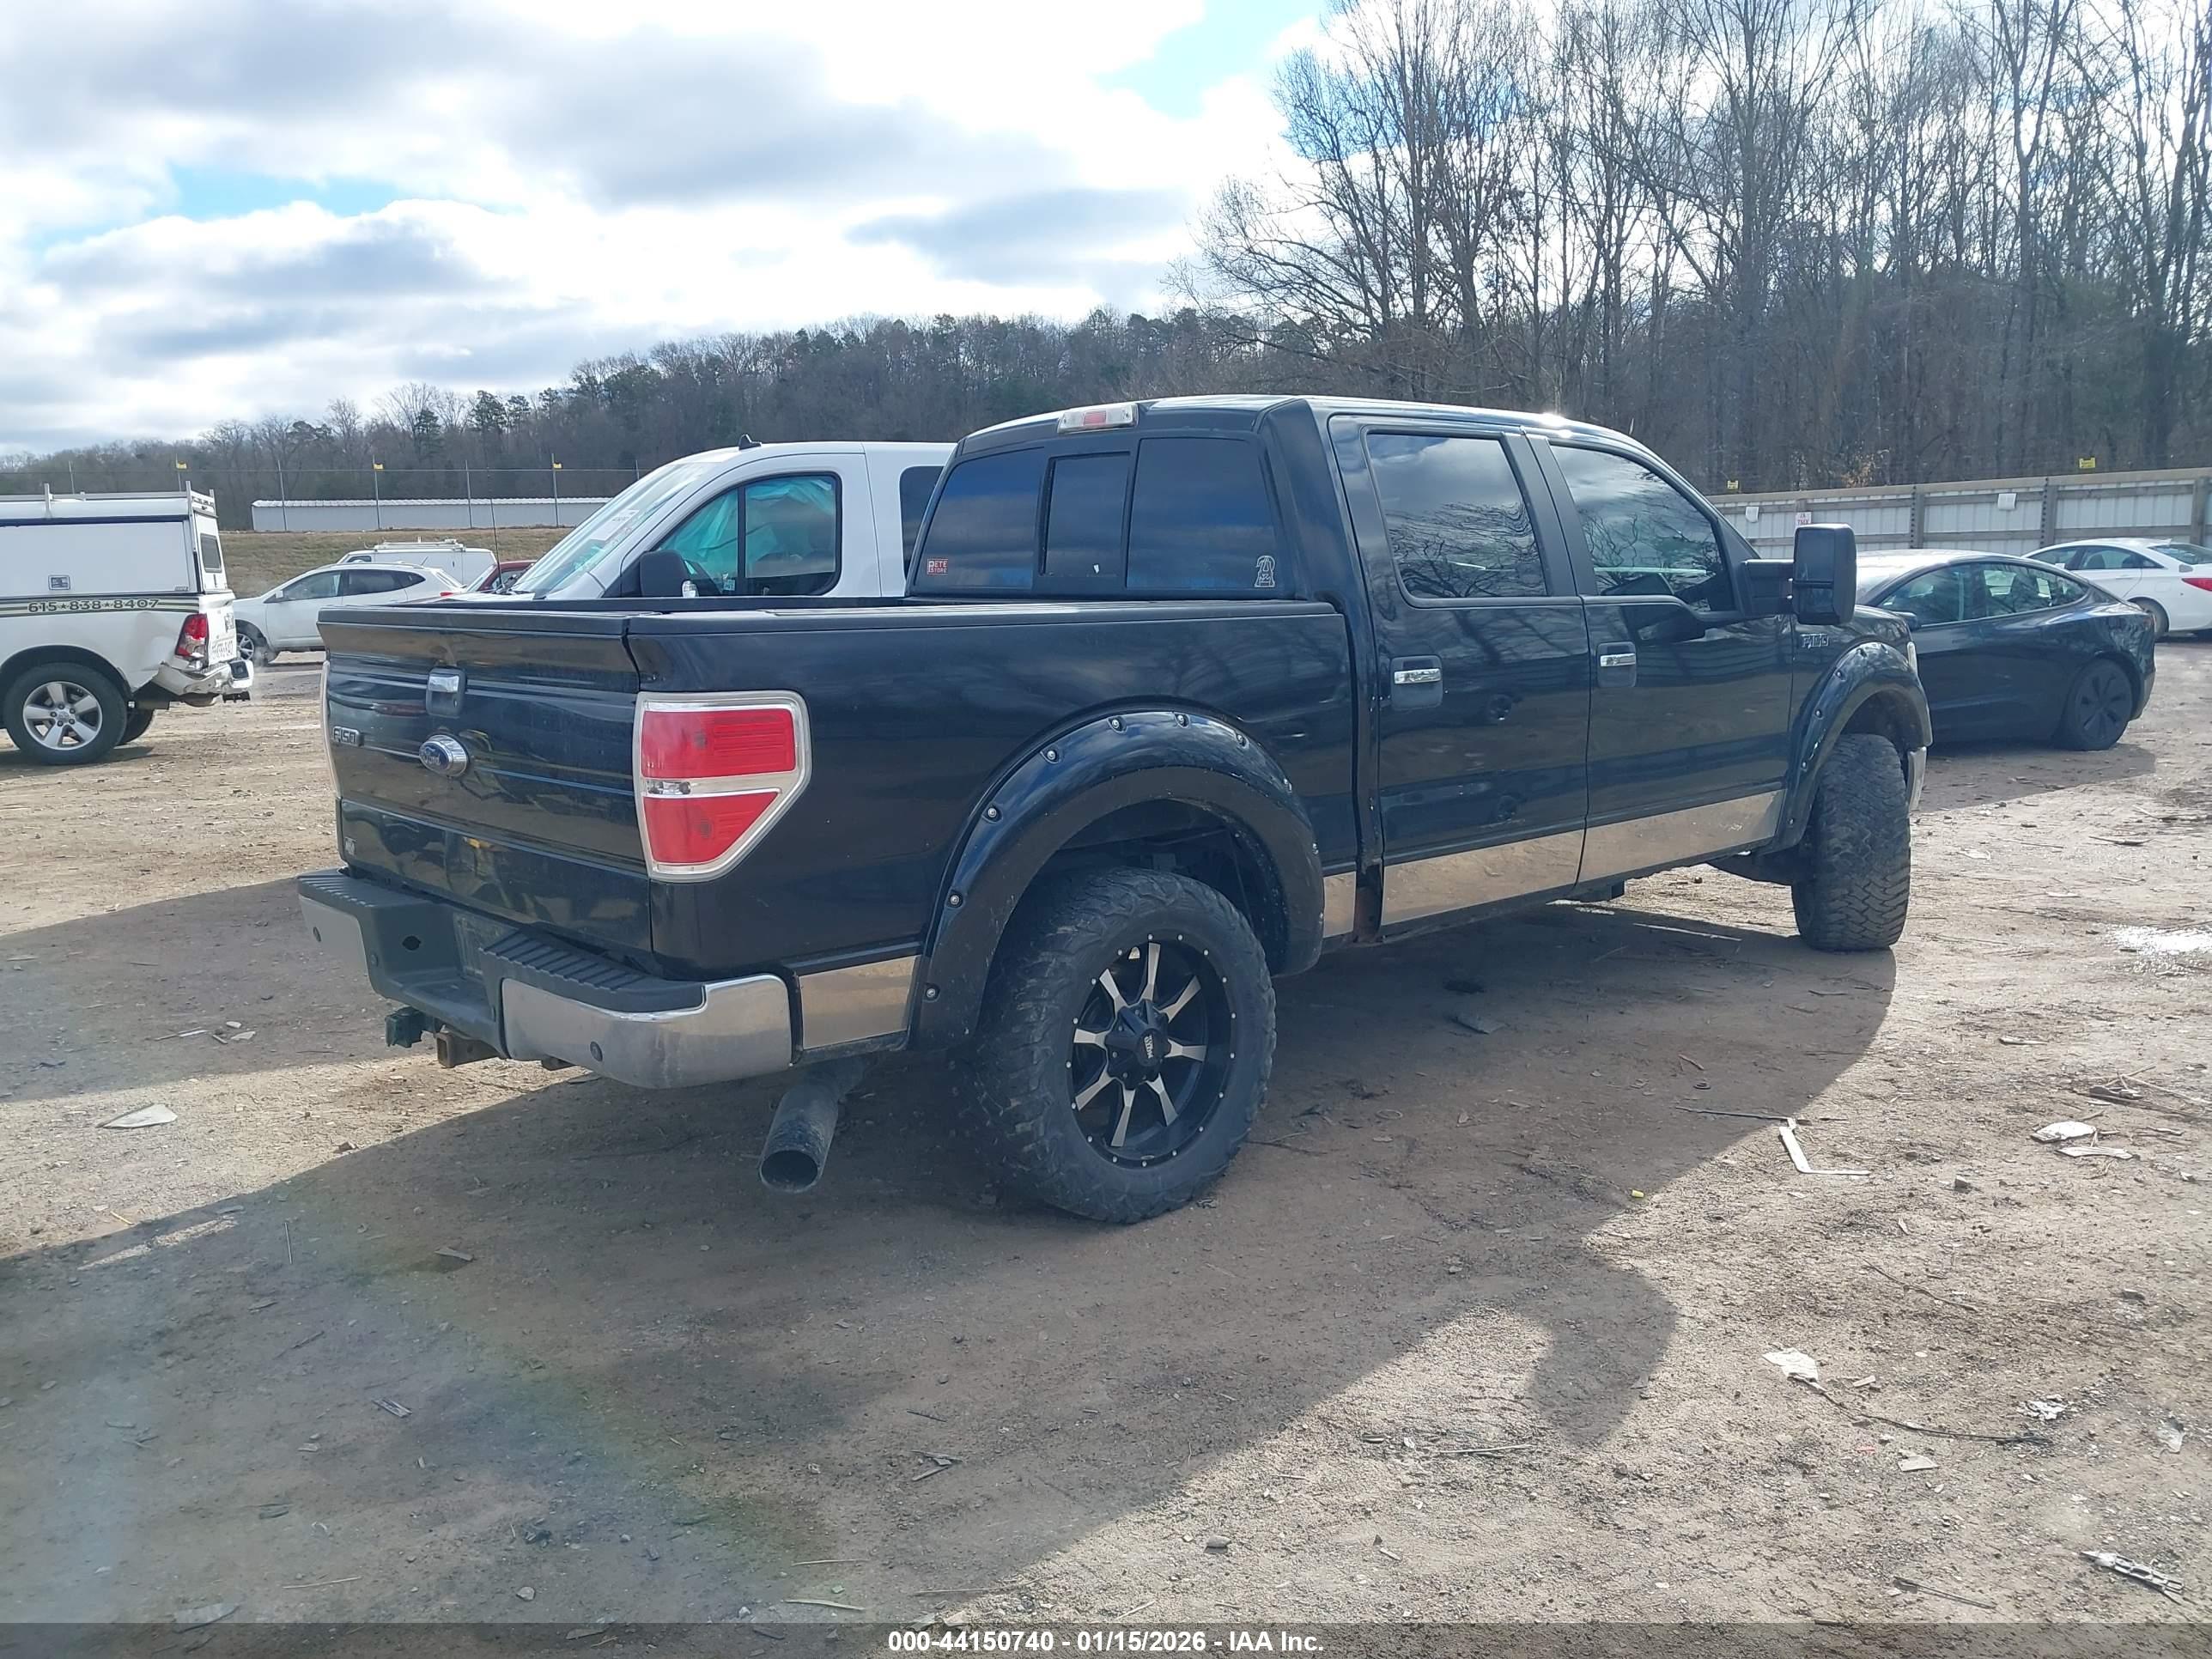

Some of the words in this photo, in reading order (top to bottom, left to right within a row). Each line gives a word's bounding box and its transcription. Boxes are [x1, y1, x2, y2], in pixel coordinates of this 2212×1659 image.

[928, 561, 948, 570] PETE
[27, 602, 58, 612] 615
[69, 600, 101, 611] 838
[112, 599, 160, 609] 8407
